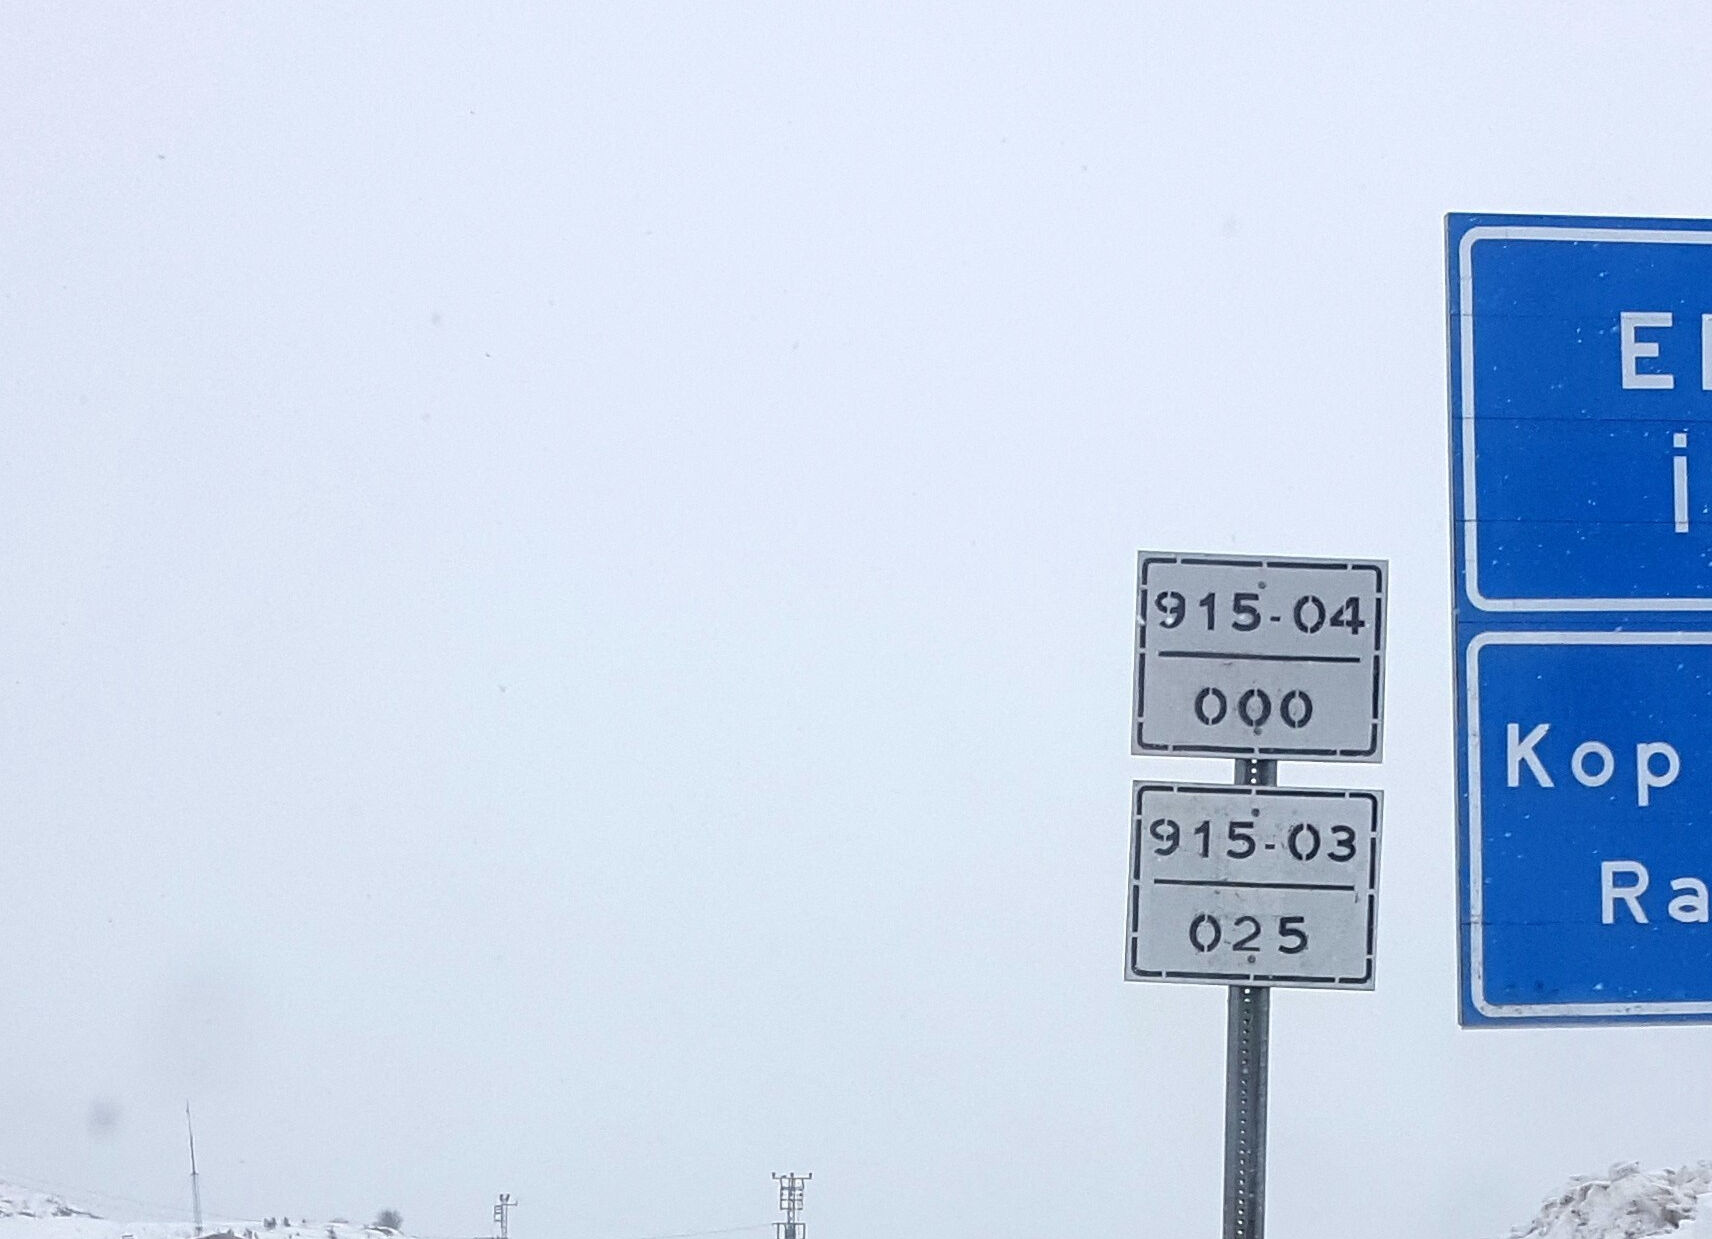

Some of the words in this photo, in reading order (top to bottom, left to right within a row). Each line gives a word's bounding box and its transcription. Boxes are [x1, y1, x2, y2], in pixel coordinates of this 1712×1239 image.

[1155, 592, 1365, 635] 915-04
[1195, 687, 1313, 728] 000
[1507, 723, 1680, 806] Kop
[1150, 819, 1356, 862] 915-03
[1189, 914, 1308, 954] 025
